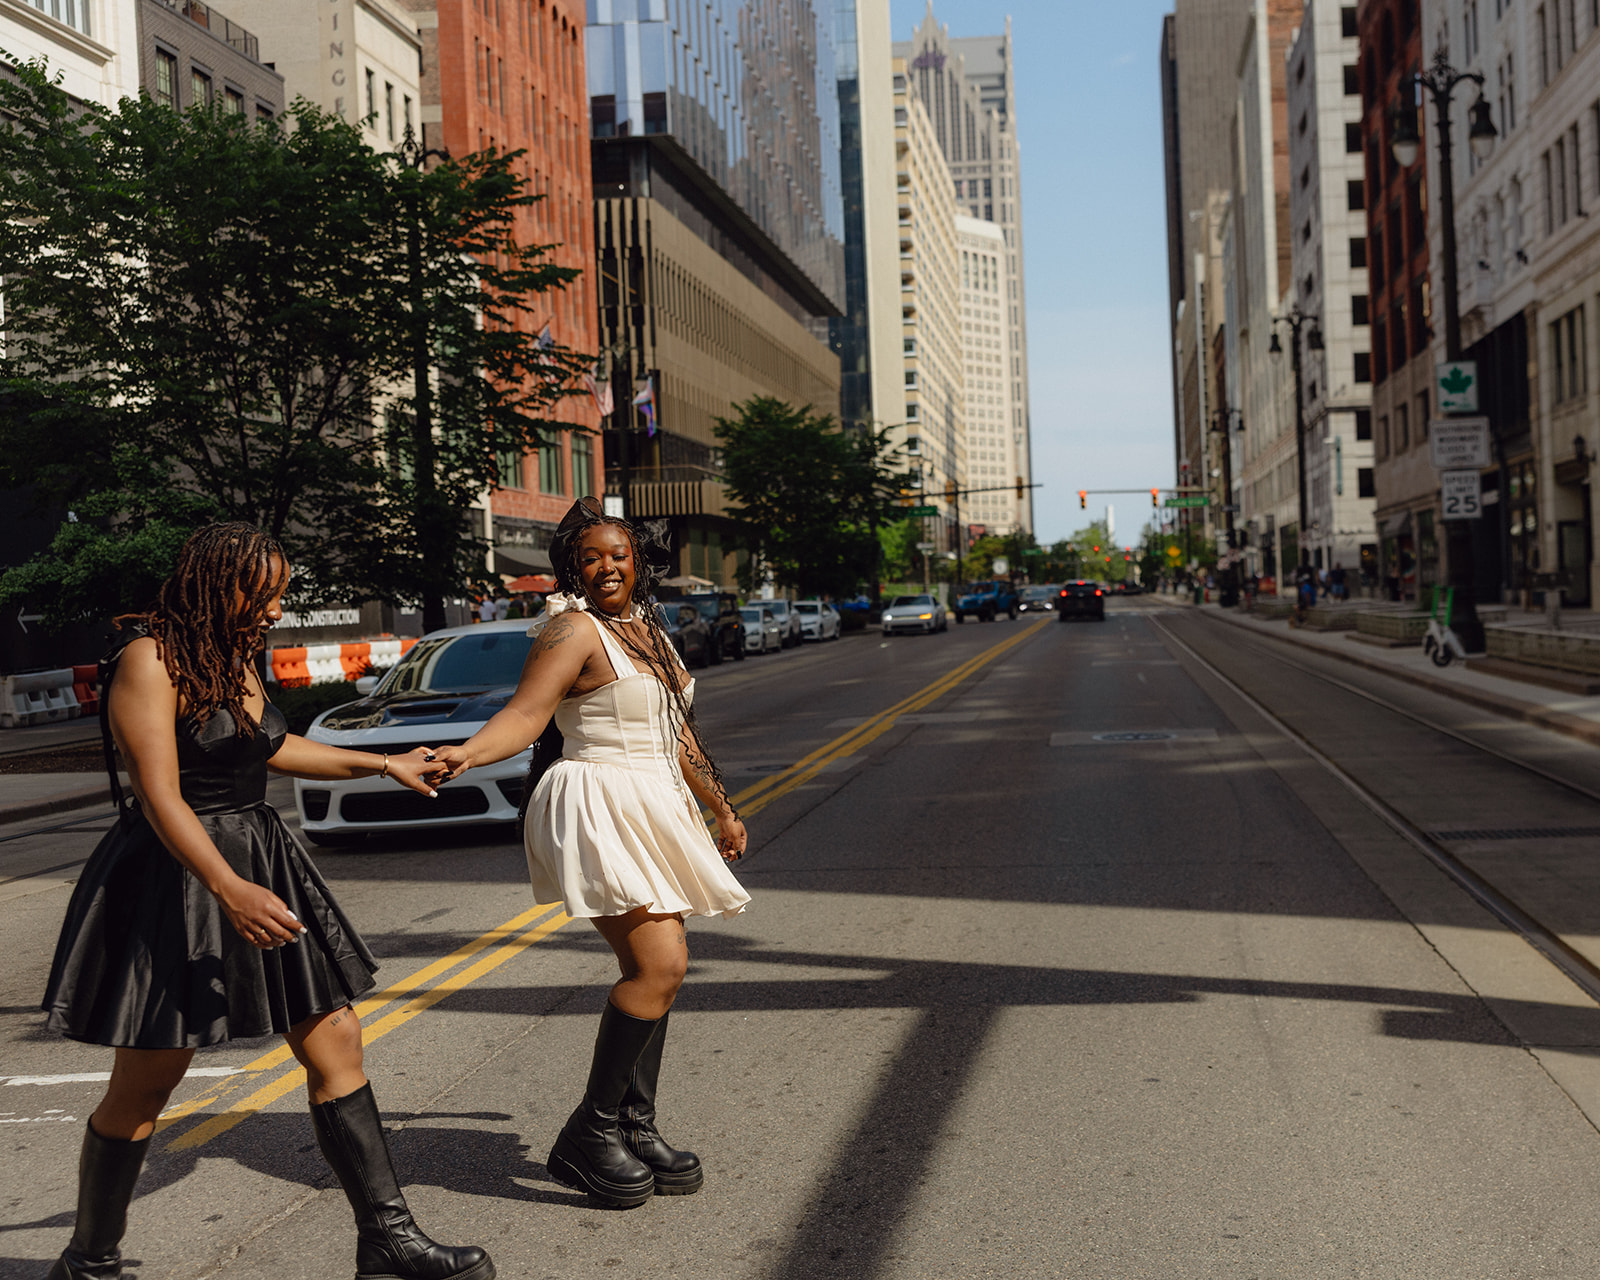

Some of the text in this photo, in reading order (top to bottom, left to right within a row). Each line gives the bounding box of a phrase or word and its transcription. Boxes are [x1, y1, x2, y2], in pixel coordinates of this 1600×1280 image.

[1446, 475, 1476, 484] SPEED
[1447, 486, 1473, 494] LIMIT
[1446, 496, 1478, 514] 25
[303, 609, 360, 627] CONSTRUCTION
